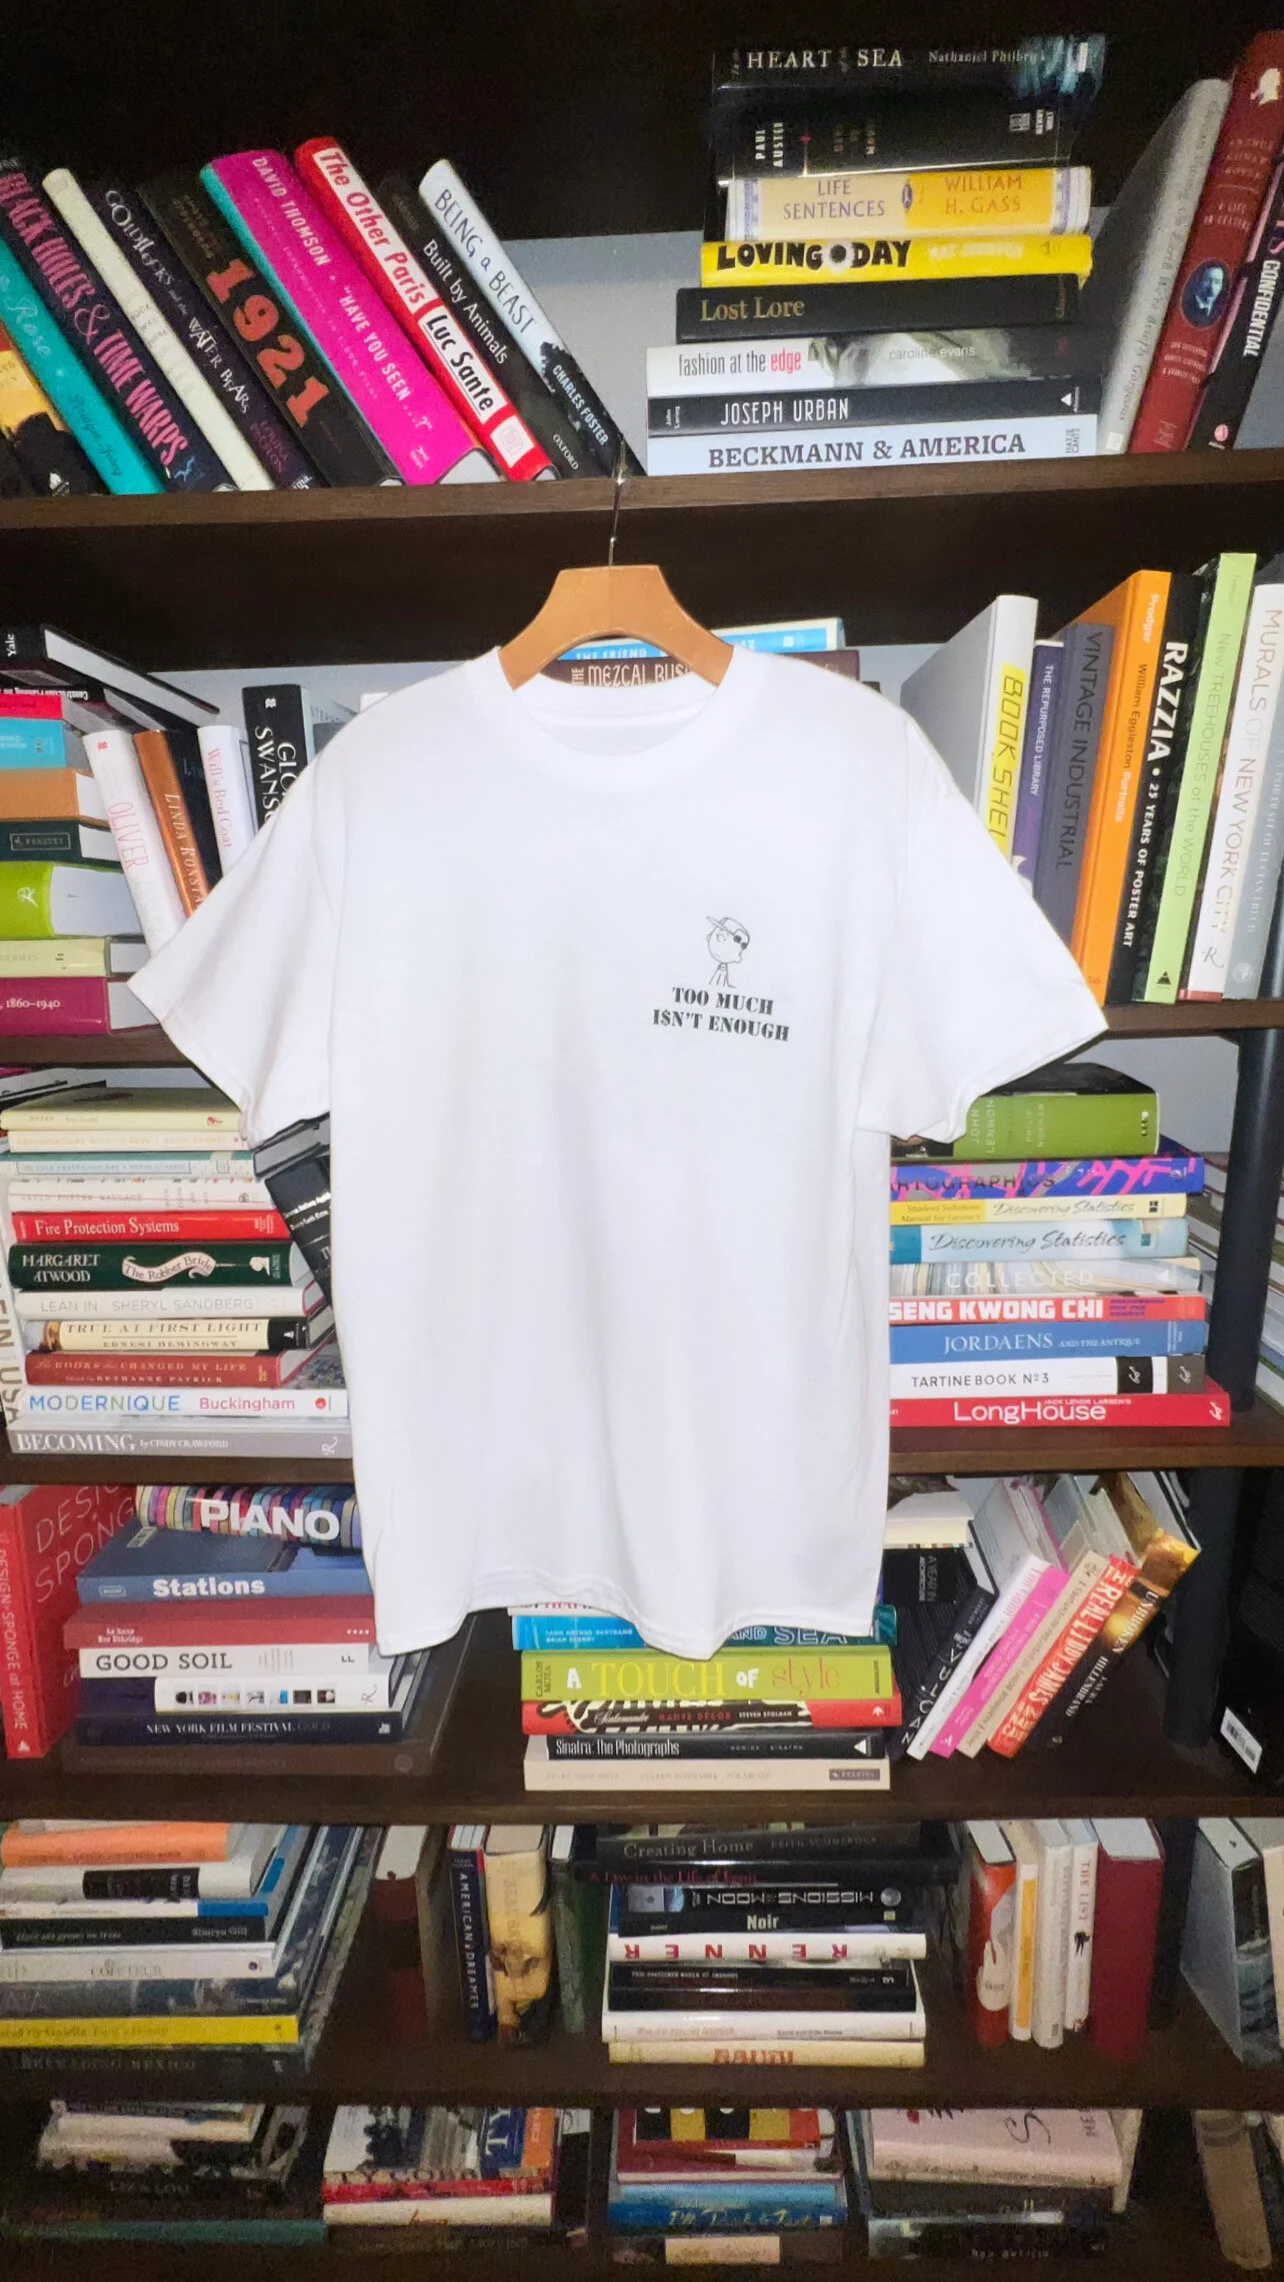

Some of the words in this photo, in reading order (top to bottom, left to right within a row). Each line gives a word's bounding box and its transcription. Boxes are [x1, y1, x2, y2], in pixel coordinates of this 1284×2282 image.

[747, 50, 832, 69] HEART
[857, 48, 903, 68] SEA
[755, 129, 766, 160] PAUL
[772, 122, 784, 168] AUSTER
[817, 180, 851, 196] LIFE
[944, 174, 1023, 191] WILLIAM
[783, 200, 886, 220] SENTENCES
[945, 199, 964, 214] H.
[970, 195, 1021, 213] GASS
[433, 188, 484, 259] BEING
[487, 270, 535, 334] BEAST
[252, 156, 288, 199] DAVID
[280, 199, 331, 268] THOMSON
[363, 328, 390, 363] YOU
[381, 359, 412, 403] SEEN
[319, 150, 351, 188] The
[345, 192, 391, 248] Other
[383, 252, 426, 306] Paris
[425, 313, 456, 352] Luc
[448, 350, 495, 413] Sante
[422, 238, 455, 283] Built
[449, 277, 470, 304] by
[463, 302, 510, 365] Animals
[699, 298, 749, 322] Lost
[753, 296, 806, 319] Lore
[1243, 259, 1282, 358] CONFIDENTIAL
[32, 236, 97, 310] HOLES
[73, 303, 111, 345] &
[92, 328, 146, 394] TIME
[124, 378, 190, 467] WARPS
[206, 257, 330, 430] 1921
[678, 352, 726, 377] fashion
[729, 354, 743, 374] at
[745, 351, 766, 373] the
[770, 347, 802, 375] edge
[888, 347, 937, 361] caroline
[939, 344, 976, 359] evans
[552, 364, 585, 411] CHARLES
[579, 402, 610, 447] FOSTER
[720, 401, 784, 426] JOSEPH
[792, 397, 849, 422] URBAN
[552, 432, 580, 471] OXFORD
[708, 440, 864, 469] BECKMANN
[872, 439, 892, 460] &
[899, 432, 1026, 459] AMERICA
[6, 632, 16, 657] Yale
[1218, 633, 1231, 670] New
[1248, 608, 1283, 712] MURALS
[570, 668, 585, 686] THE
[1044, 664, 1055, 681] THE
[1073, 631, 1104, 731] VINTAGE
[1130, 664, 1149, 708] William
[996, 675, 1024, 760] BOOK
[1036, 683, 1052, 751] REPURPOSED
[1147, 642, 1190, 762] RAZZIA
[1124, 710, 1141, 769] Eggleston
[1191, 673, 1225, 782] TREEHOUSES
[1244, 716, 1264, 750] OF
[206, 746, 223, 782] Will's
[1030, 752, 1042, 796] LIBRARY
[212, 782, 227, 814] Red
[1114, 771, 1131, 823] Portraits
[1234, 757, 1257, 815] NEW
[163, 792, 190, 842] LINDA
[1055, 736, 1090, 869] INDUSTRIAL
[107, 800, 150, 870] OLIVER
[217, 815, 233, 848] Coat
[1139, 804, 1156, 846] YEARS
[1185, 807, 1201, 834] the
[1137, 848, 1149, 867] OF
[1218, 815, 1245, 880] YORK
[1174, 838, 1196, 897] WORLD
[1129, 870, 1145, 921] POSTER
[1209, 882, 1234, 935] CITY
[1123, 921, 1137, 948] ART
[671, 986, 710, 1007] TOO
[716, 992, 774, 1016] MUCH
[707, 1014, 790, 1043] ENOUGH
[970, 1109, 980, 1144] JOHN
[986, 1099, 995, 1154] LENNON
[992, 1201, 1071, 1217] Discovering
[1072, 1200, 1136, 1215] Statistics
[35, 1219, 61, 1236] Fire
[63, 1217, 126, 1236] Protection
[128, 1216, 180, 1235] Systems
[929, 1233, 1035, 1252] Discovering
[1040, 1228, 1127, 1250] Statistics
[22, 1252, 101, 1267] MARGARET
[33, 1268, 91, 1283] ATWOOD
[123, 1262, 147, 1280] The
[147, 1257, 183, 1280] Robber
[183, 1254, 215, 1273] Bride
[945, 1270, 1093, 1290] COLLECTED
[40, 1299, 79, 1313] LEAN
[83, 1299, 98, 1312] IN
[111, 1298, 168, 1312] SHERYL
[172, 1296, 254, 1311] SANDBERG
[889, 1298, 953, 1322] SENG
[959, 1296, 1056, 1320] KWONG
[1061, 1295, 1103, 1318] CHI
[66, 1323, 113, 1334] TRUE
[119, 1323, 141, 1334] AT
[147, 1322, 199, 1334] FIRST
[207, 1322, 262, 1334] LIGHT
[944, 1334, 1053, 1355] JORDAENS
[54, 1361, 103, 1371] BOOKS
[119, 1362, 185, 1372] CHANGED
[191, 1363, 209, 1372] MY
[215, 1363, 248, 1372] LIFE
[910, 1373, 973, 1388] TARTINE
[975, 1372, 1017, 1386] BOOK
[29, 1394, 181, 1412] MODERNIQUE
[199, 1396, 296, 1414] Buckingham
[954, 1401, 1107, 1425] LongHouse
[17, 1433, 136, 1453] BECOMING
[139, 1438, 149, 1449] by
[149, 1438, 177, 1449] CINDY
[177, 1437, 229, 1449] CRAWFORD
[198, 1497, 341, 1541] PIANO
[152, 1577, 266, 1598] Stations
[1102, 1564, 1134, 1589] THE
[1081, 1580, 1123, 1627] REAL
[773, 1625, 848, 1645] SEA
[1110, 1589, 1159, 1656] UNBROKEN
[95, 1654, 169, 1671] GOOD
[178, 1653, 233, 1670] SOIL
[566, 1667, 582, 1689] A
[589, 1660, 728, 1698] TOUCH
[771, 1657, 842, 1698] style
[1027, 1658, 1071, 1707] JAMES
[1064, 1655, 1109, 1718] HILLENBRAND
[146, 1723, 172, 1735] NEW
[175, 1722, 207, 1734] YORK
[209, 1721, 239, 1733] FILM
[555, 1738, 594, 1756] Sinatra:
[614, 1738, 680, 1758] Photographs
[623, 1841, 696, 1860] Creating
[702, 1838, 754, 1854] Home
[1079, 1861, 1091, 1888] THE
[458, 1872, 474, 1943] AMERICAN
[706, 1891, 767, 1905] MOON
[777, 1891, 874, 1905] MISSIONS
[746, 1914, 781, 1931] Noir
